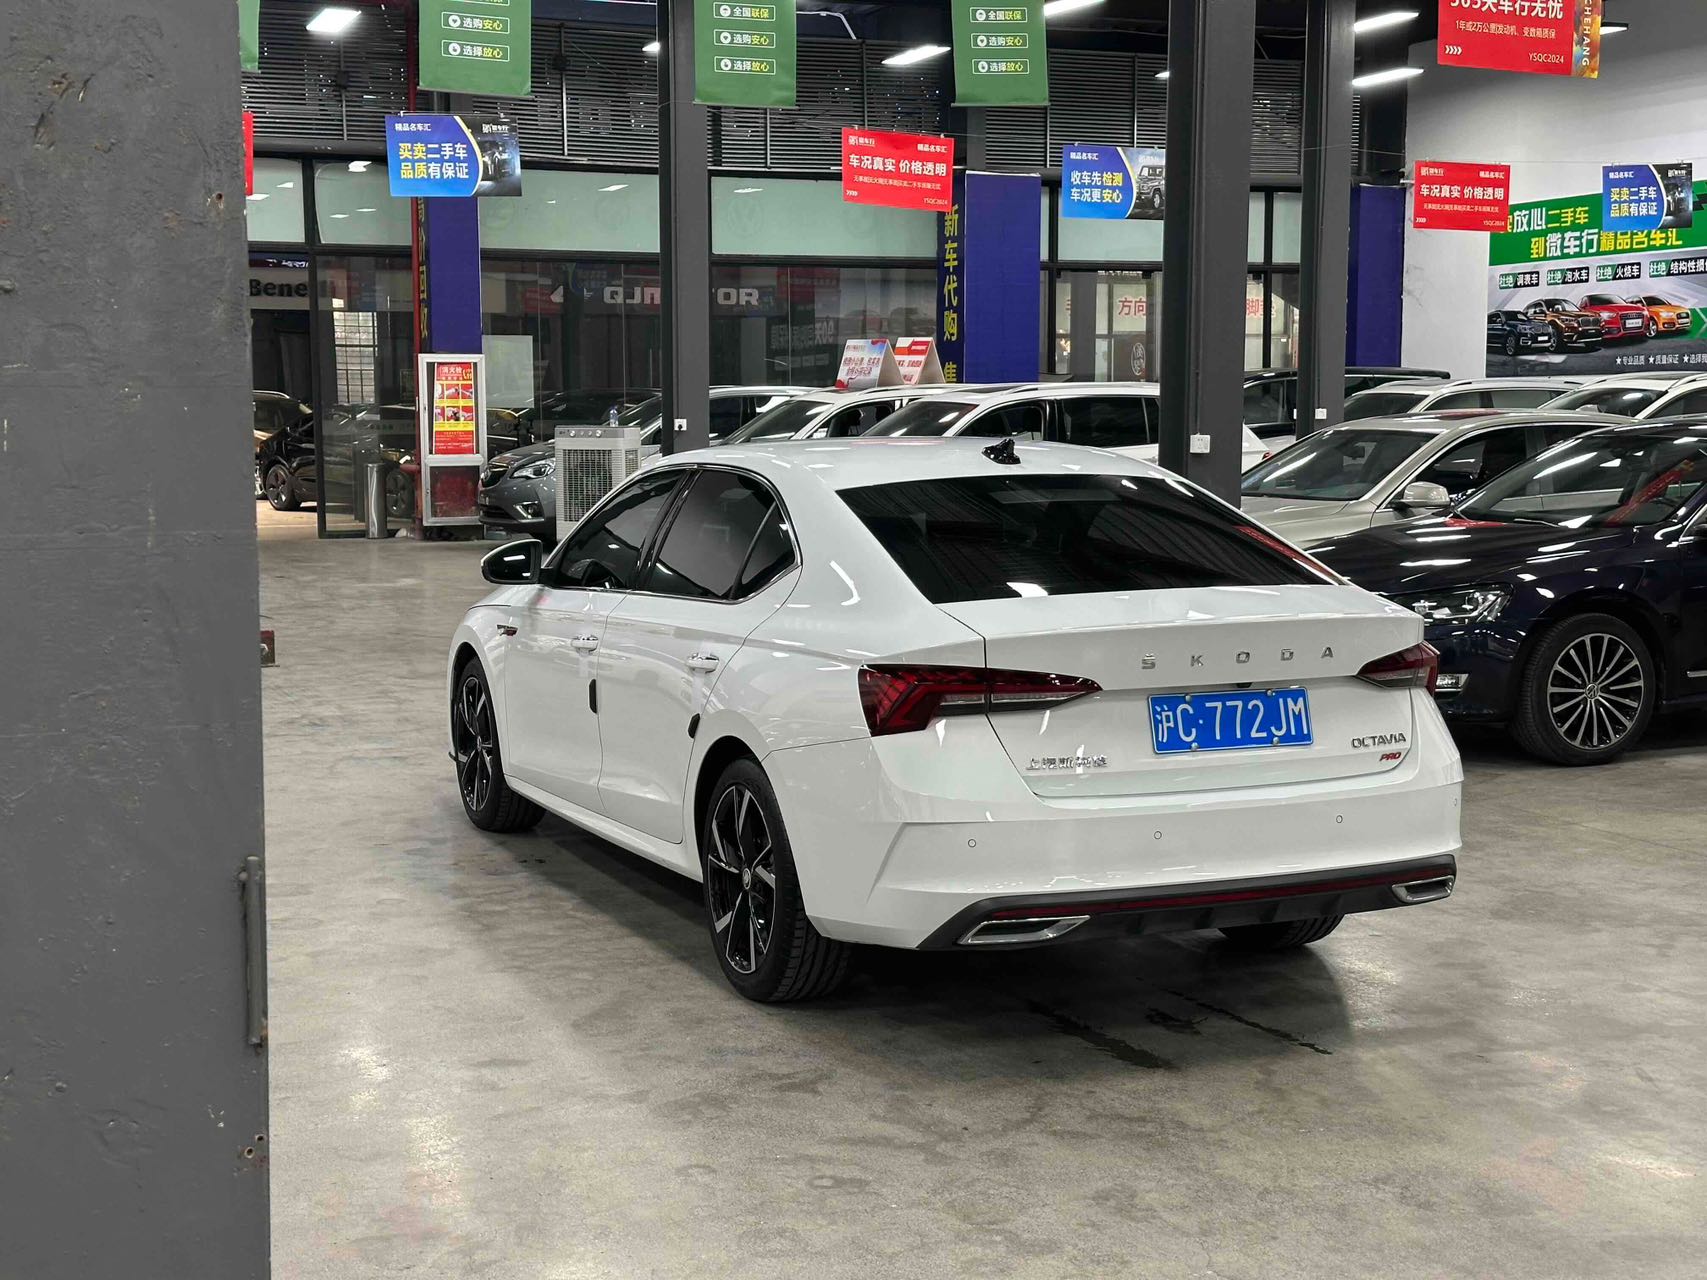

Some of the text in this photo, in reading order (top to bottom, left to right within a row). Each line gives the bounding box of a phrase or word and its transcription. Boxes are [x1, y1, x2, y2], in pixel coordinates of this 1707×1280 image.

[733, 7, 770, 19] 全国联保
[988, 10, 1022, 21] 全国联保
[463, 17, 503, 31] 选购安心
[733, 33, 770, 46] 选购安心
[988, 36, 1023, 47] 选购安心
[463, 45, 503, 59] 选择放心
[1529, 52, 1565, 64] YSQC2024
[733, 60, 770, 73] 选择放心
[989, 62, 1024, 73] 选择放心
[394, 123, 432, 132] 精品名车汇
[398, 142, 469, 160] 买卖二手车
[400, 162, 470, 180] 品质有保证
[848, 154, 948, 178] 车况真实 价格透明
[1070, 170, 1124, 187] 收车先检测
[1070, 187, 1123, 204] 车况更安心
[1420, 183, 1506, 201] 车况真实 价格透明
[1609, 186, 1658, 202] 买卖二手车
[1609, 201, 1659, 218] 品质有保证
[944, 204, 959, 343] 新车代购
[1564, 269, 1589, 283] 泡水车
[1616, 264, 1641, 279] 火烧车
[603, 286, 759, 306] QJMOR
[1352, 733, 1406, 748] OCTAVIA
[1379, 752, 1401, 761] PRO
